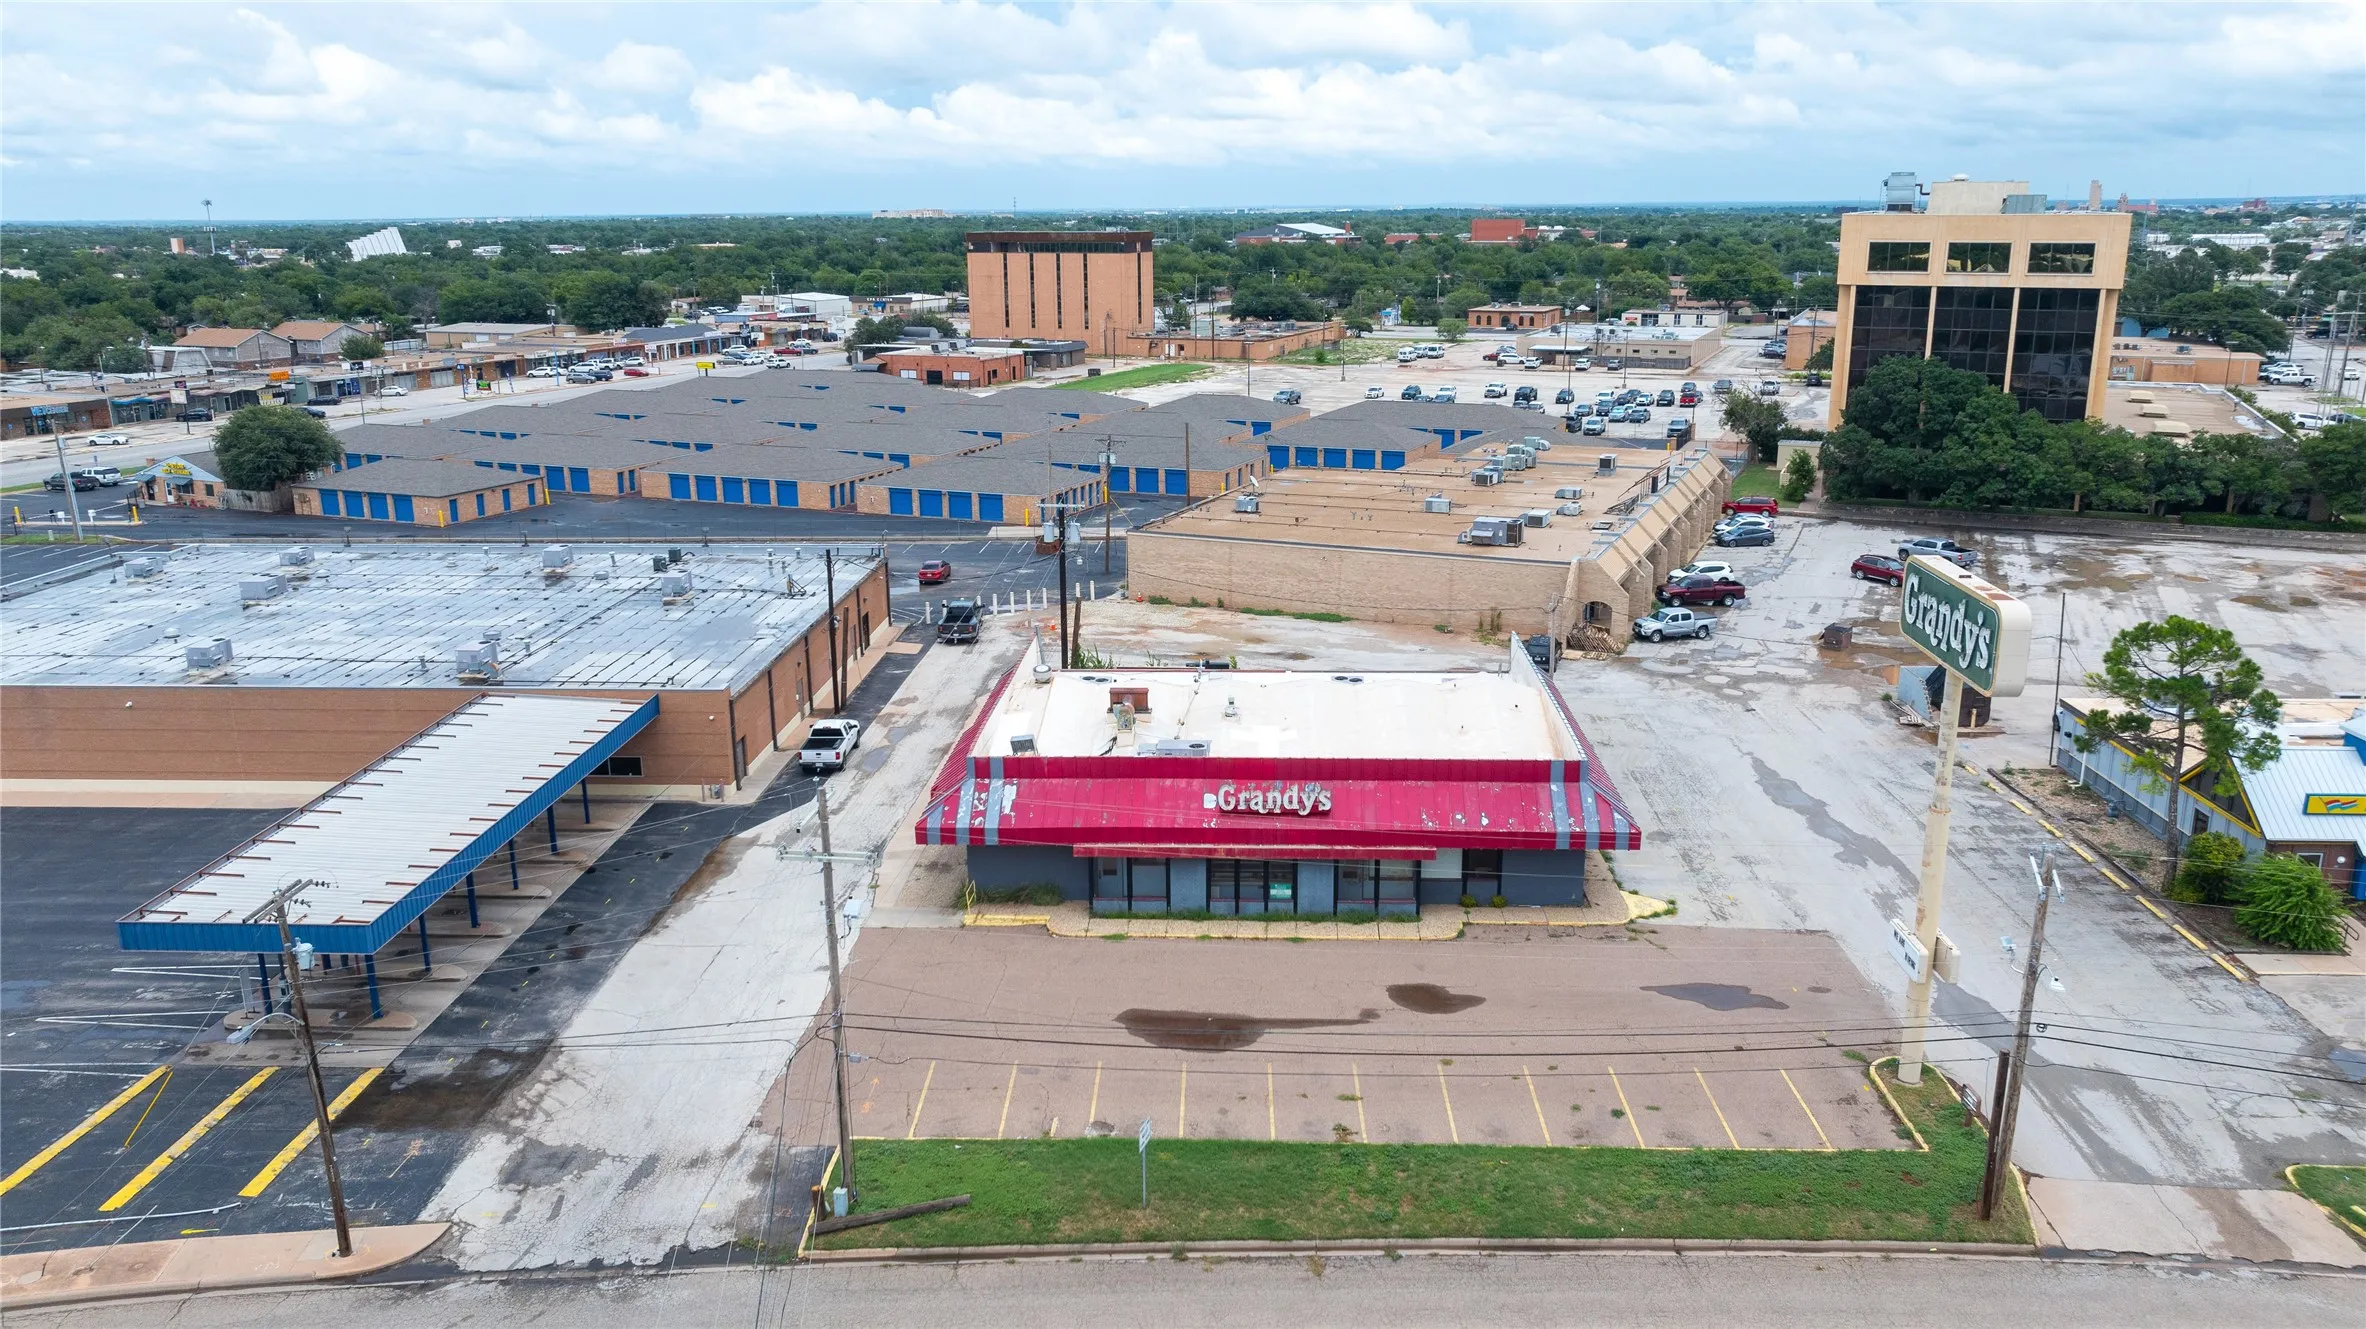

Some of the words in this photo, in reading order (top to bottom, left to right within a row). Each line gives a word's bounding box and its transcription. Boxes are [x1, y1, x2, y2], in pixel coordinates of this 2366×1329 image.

[1904, 573, 1991, 669] Grandy's
[1217, 783, 1332, 816] Grandy's
[1894, 929, 1899, 940] WE
